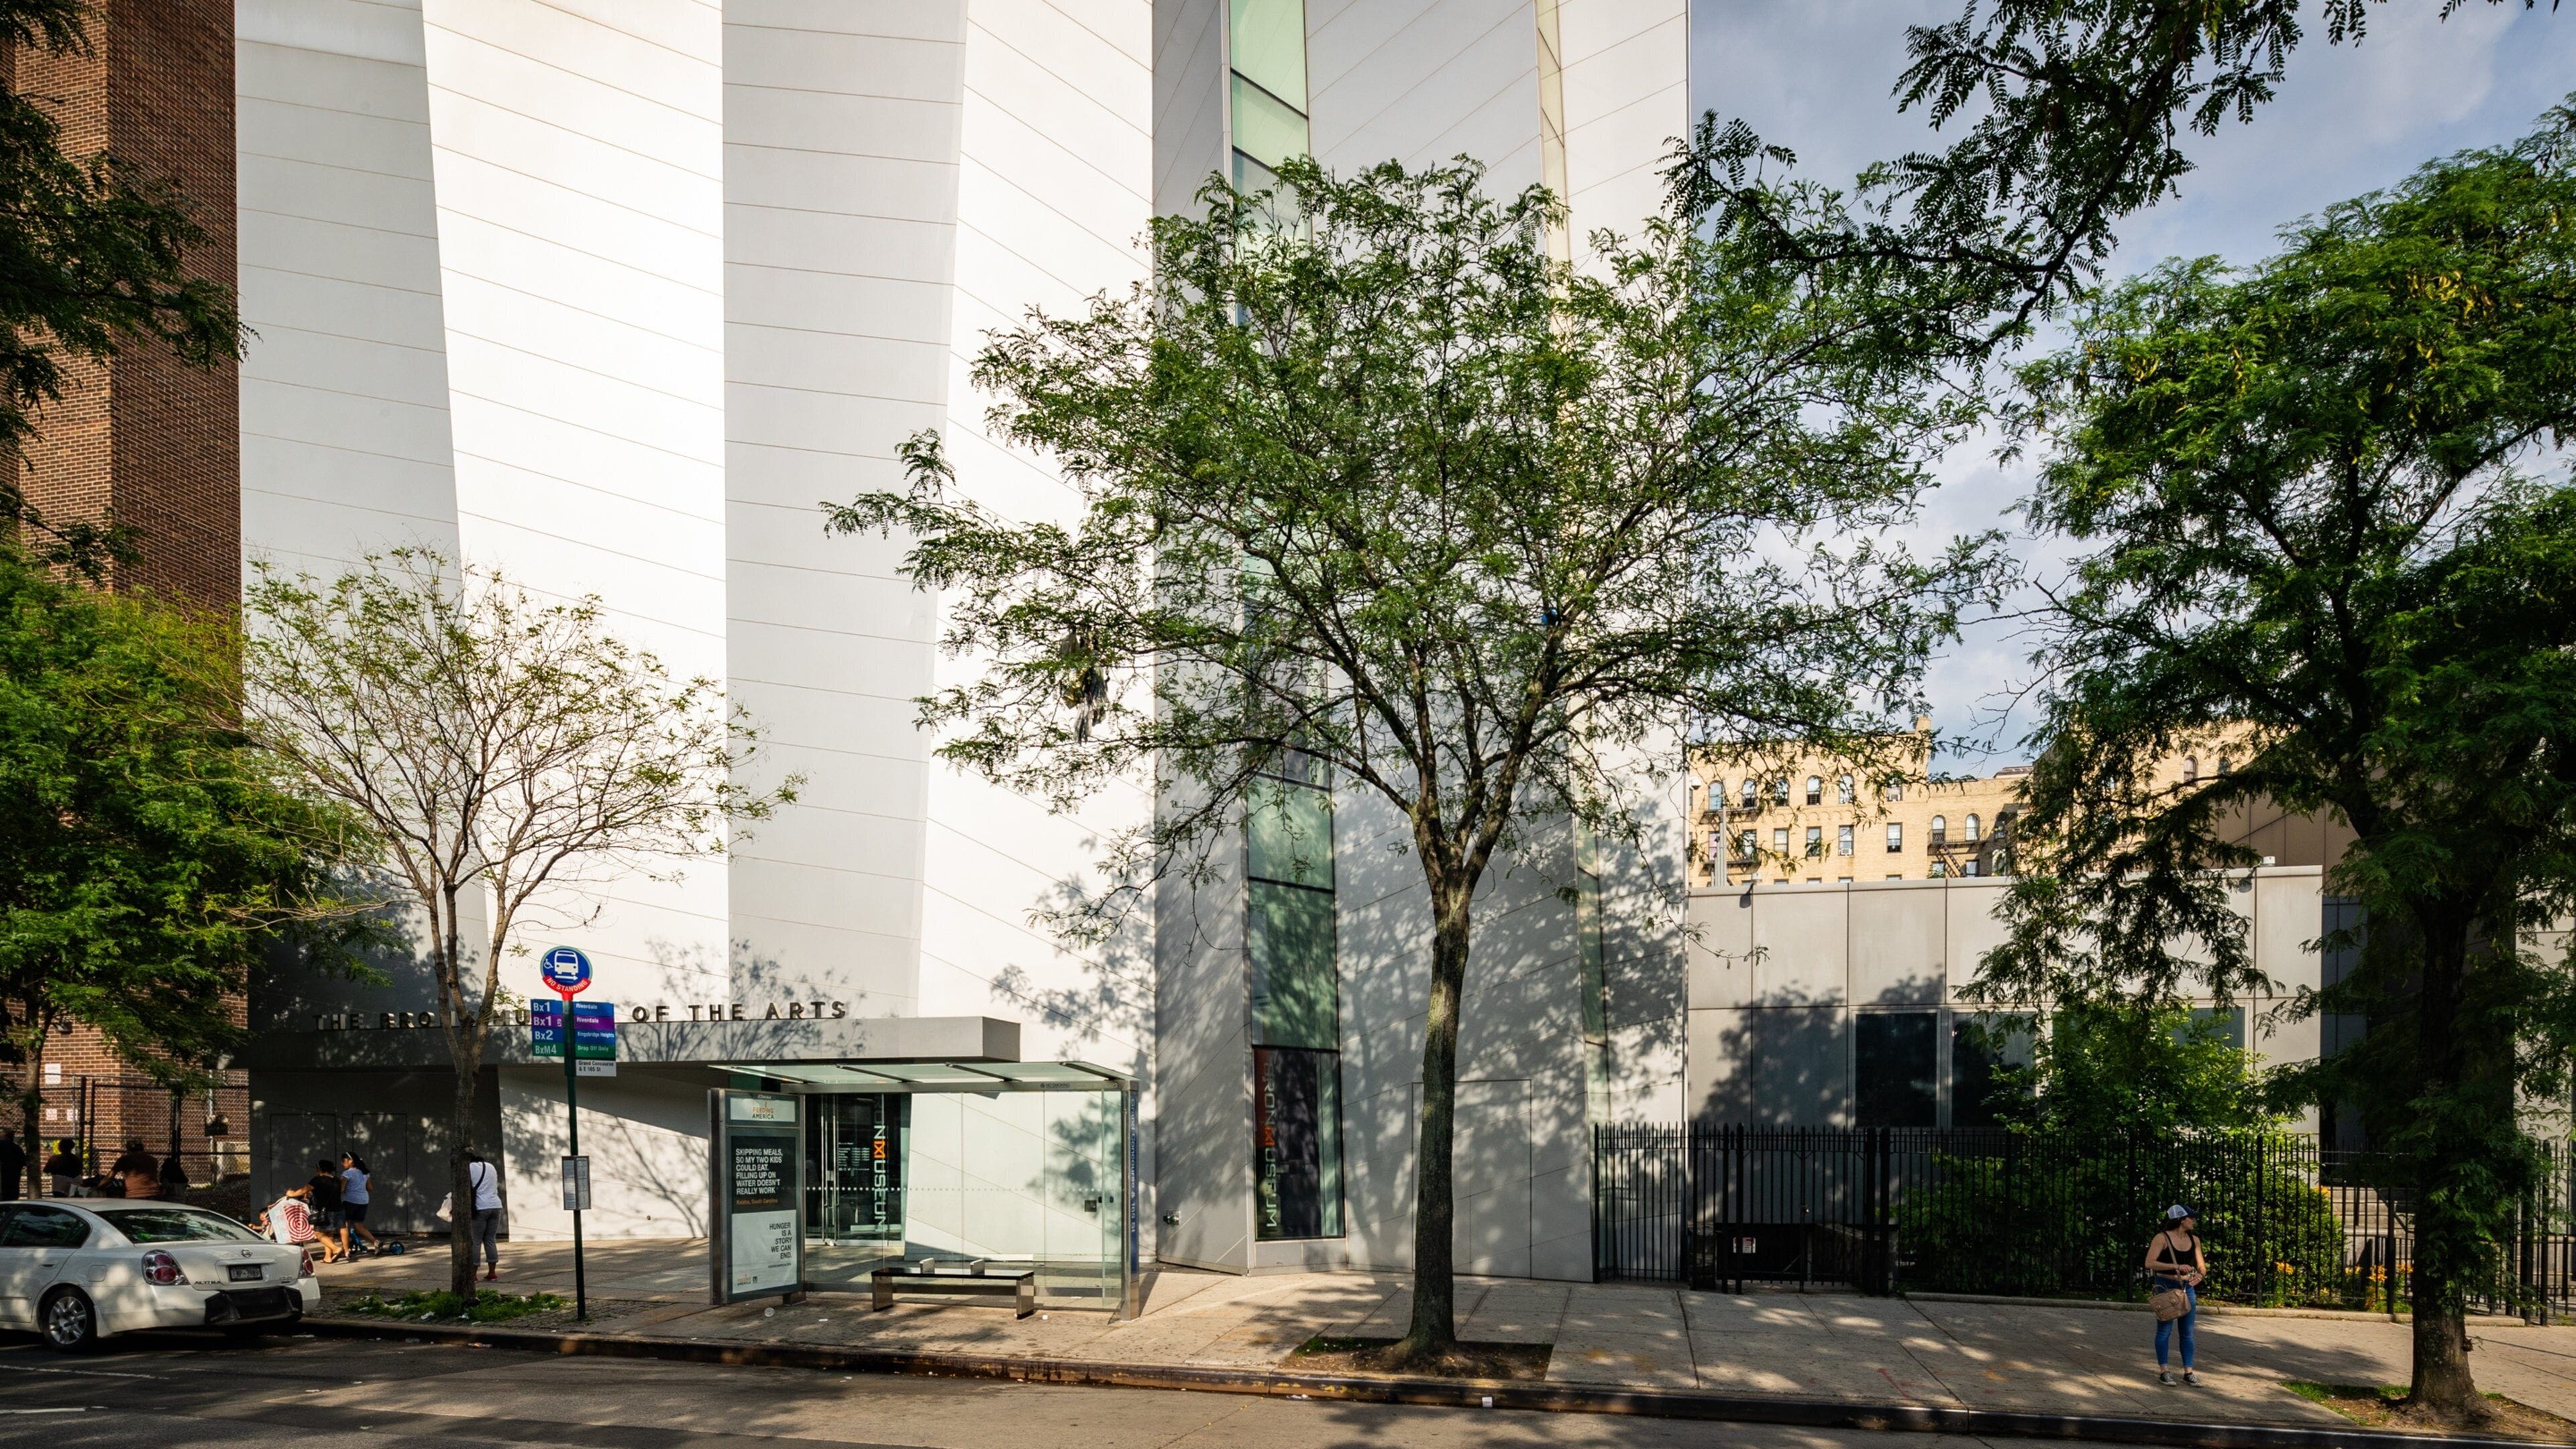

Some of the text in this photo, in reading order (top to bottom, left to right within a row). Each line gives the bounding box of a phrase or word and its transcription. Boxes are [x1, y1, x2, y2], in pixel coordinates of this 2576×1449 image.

[547, 977, 588, 991] NO STANDING
[533, 1002, 550, 1012] Bx1
[632, 1001, 846, 1023] OF THE ARTS
[313, 1014, 364, 1030] THE
[533, 1016, 552, 1026] Bx1
[535, 1030, 553, 1040] Bx2
[535, 1044, 557, 1055] BxM4
